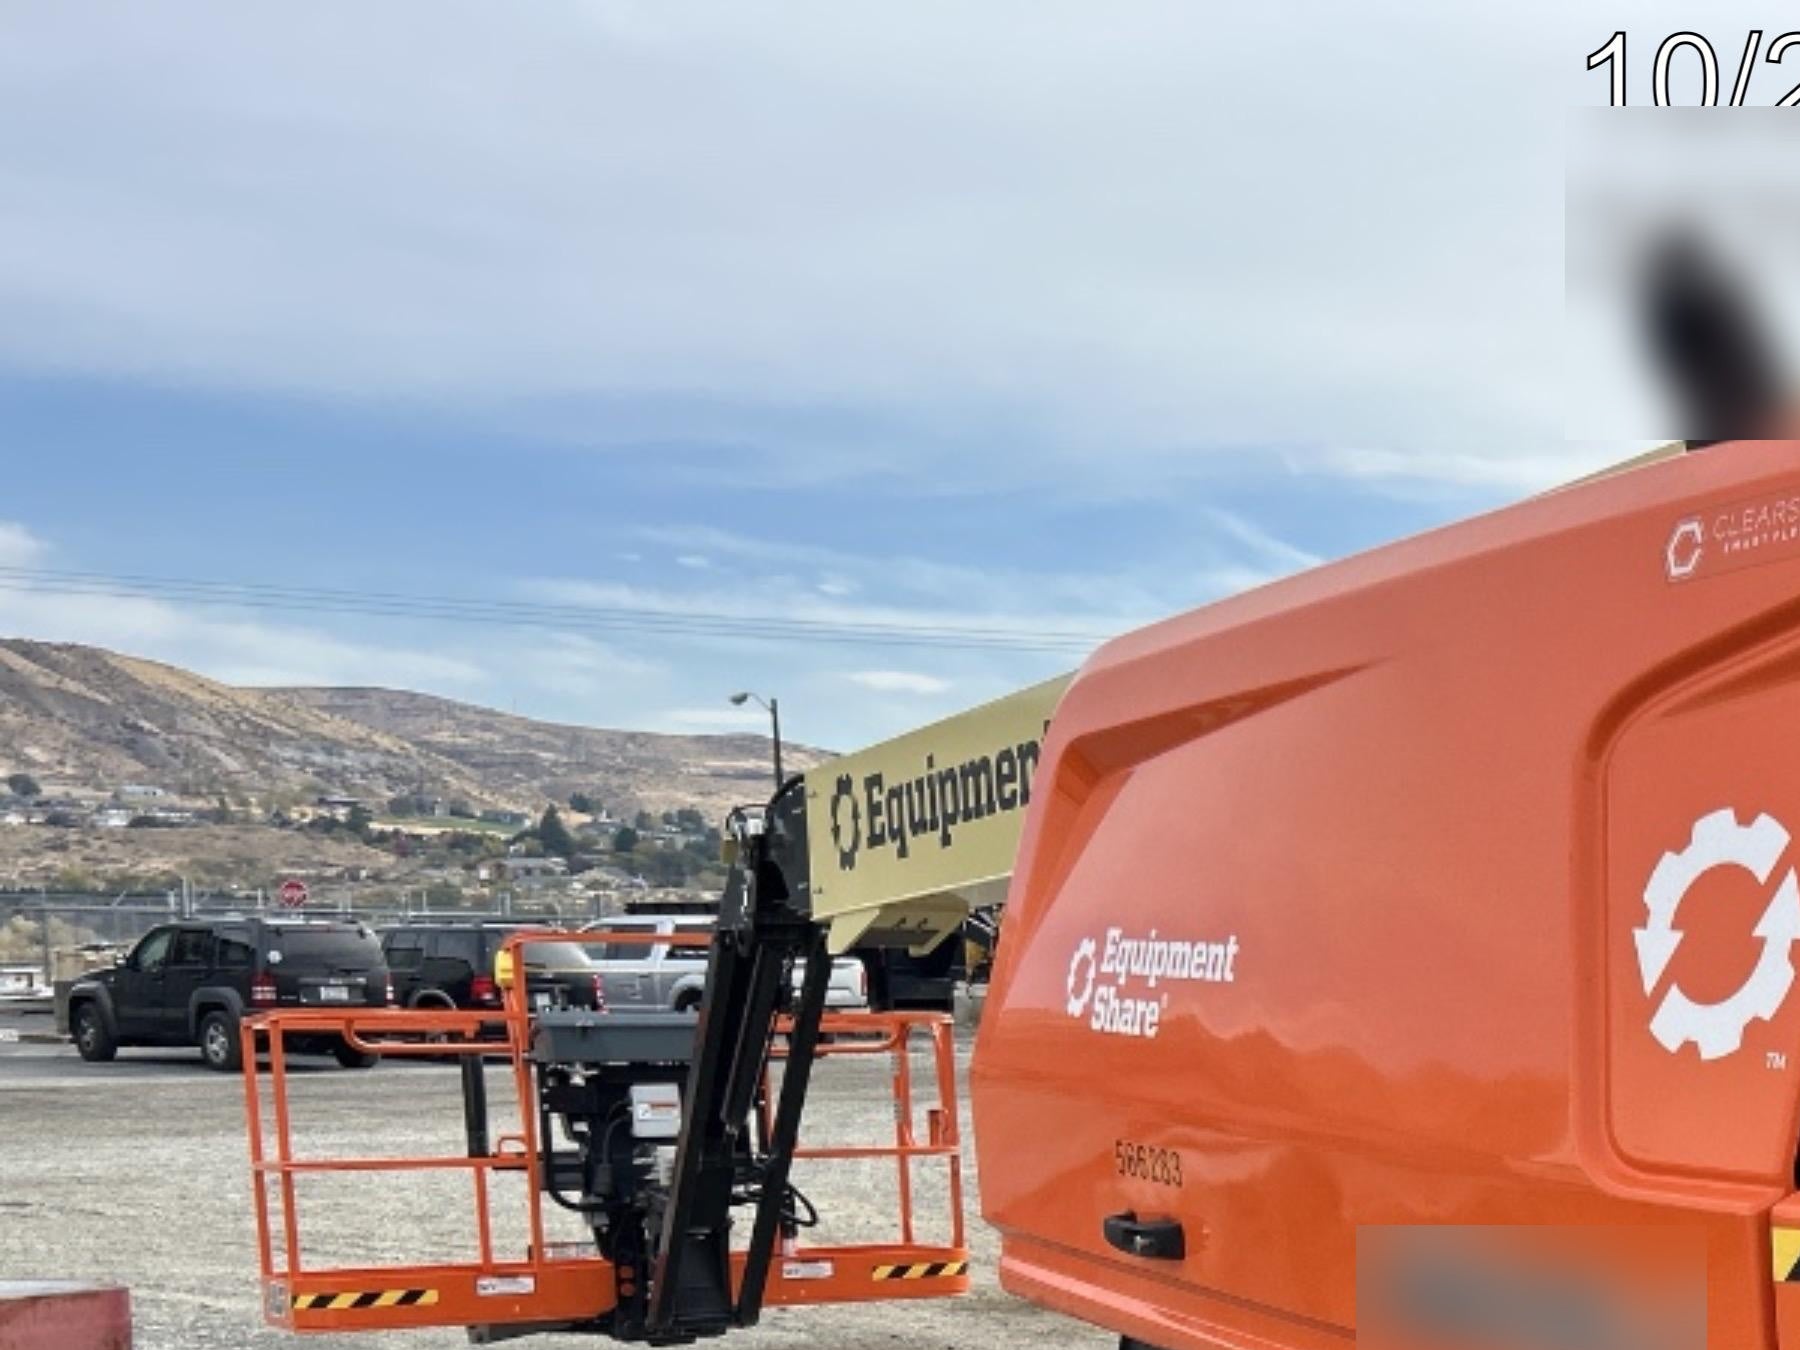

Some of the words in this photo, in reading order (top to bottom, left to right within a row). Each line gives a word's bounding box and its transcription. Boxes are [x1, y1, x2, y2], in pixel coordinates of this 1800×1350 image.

[864, 719, 1052, 859] Equipmen
[1100, 926, 1239, 987] Equipment
[1090, 985, 1160, 1038] Share
